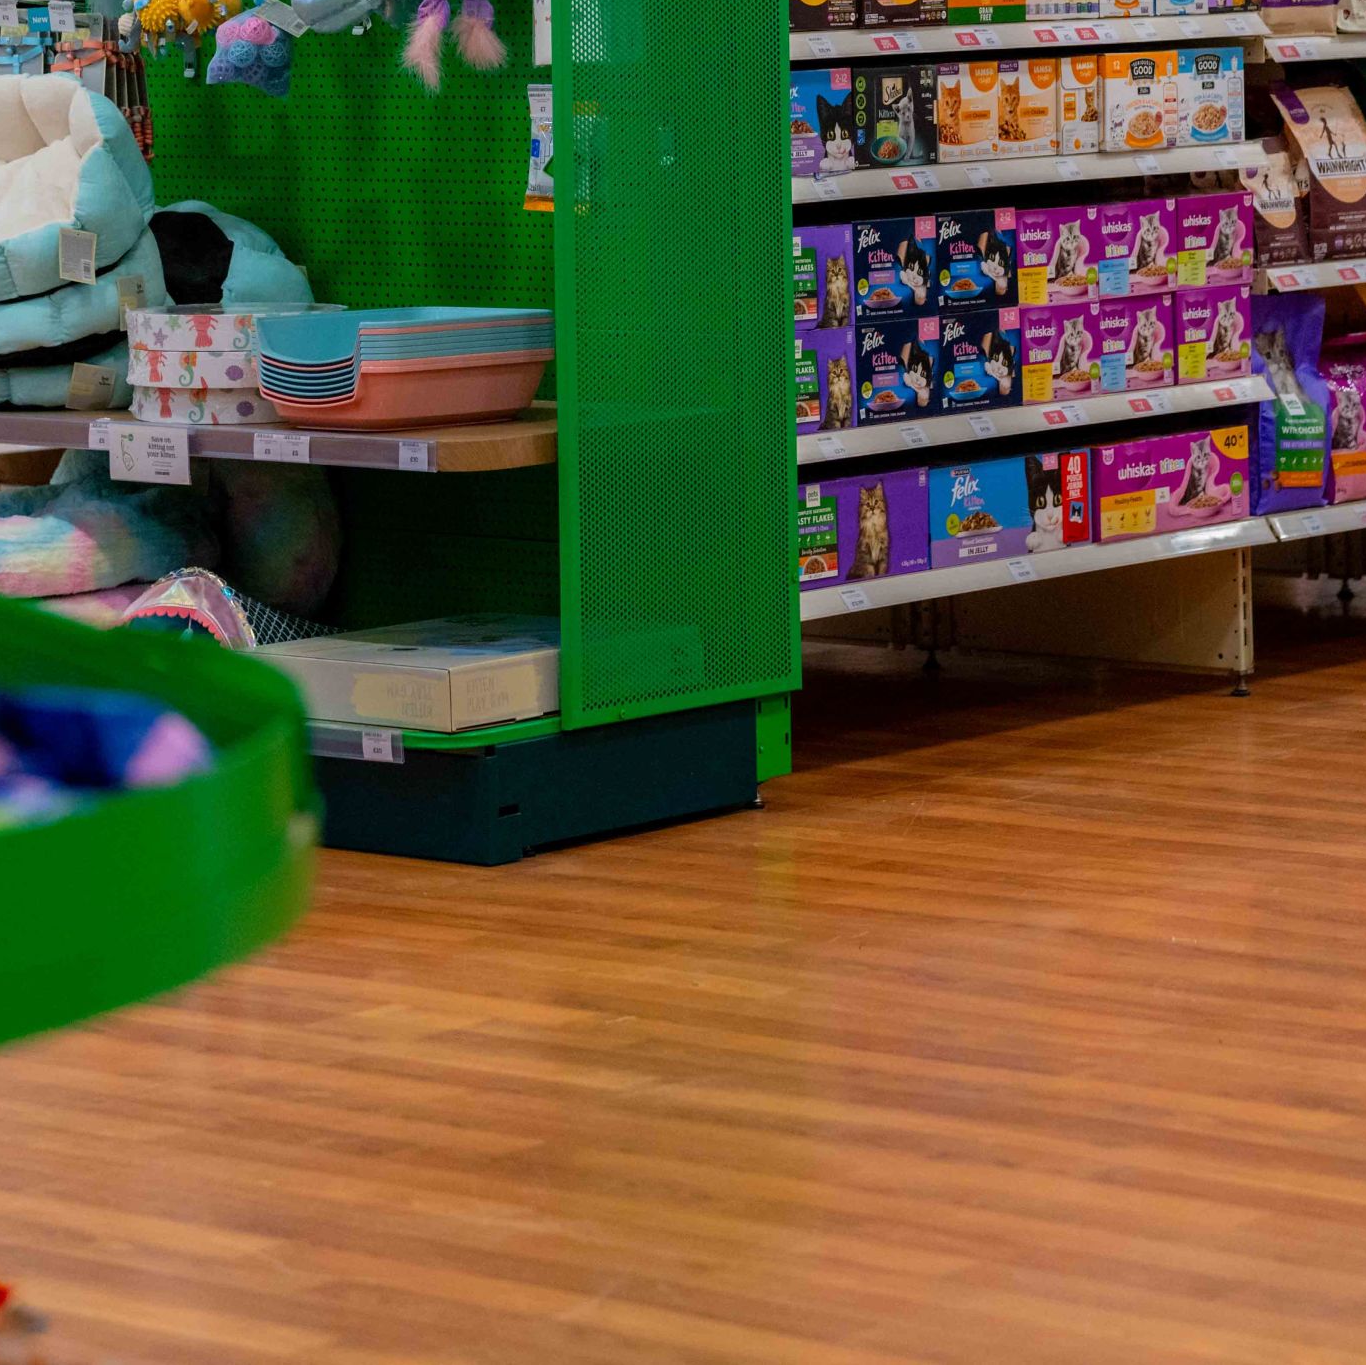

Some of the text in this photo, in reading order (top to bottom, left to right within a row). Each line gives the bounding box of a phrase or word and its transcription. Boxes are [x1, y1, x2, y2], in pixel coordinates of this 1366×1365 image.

[32, 14, 49, 25] New
[979, 13, 992, 22] FREE
[1133, 65, 1153, 76] GOOD
[1197, 61, 1218, 71] GOOD
[834, 73, 848, 84] 2-12
[884, 86, 903, 104] Sheba
[1182, 214, 1212, 227] whiskas
[938, 220, 962, 245] felix
[1101, 221, 1133, 234] whiskas
[857, 228, 882, 252] felix
[1020, 228, 1051, 242] whiskas
[949, 242, 976, 254] Kitten
[868, 251, 895, 263] Kitten
[795, 263, 814, 272] FLAKES
[1182, 307, 1211, 320] whiskas
[1099, 316, 1130, 330] whiskas
[942, 322, 966, 346] felix
[1025, 325, 1056, 339] whiskas
[861, 332, 885, 356] felix
[953, 342, 979, 355] Kitten
[872, 353, 899, 366] Kitten
[796, 365, 815, 374] FLAKES
[1223, 434, 1238, 450] 40
[1066, 455, 1081, 475] 40
[1117, 461, 1157, 481] whiskas
[950, 475, 981, 506] felix
[812, 512, 835, 523] FLAKES
[967, 545, 989, 555] IN JELLY
